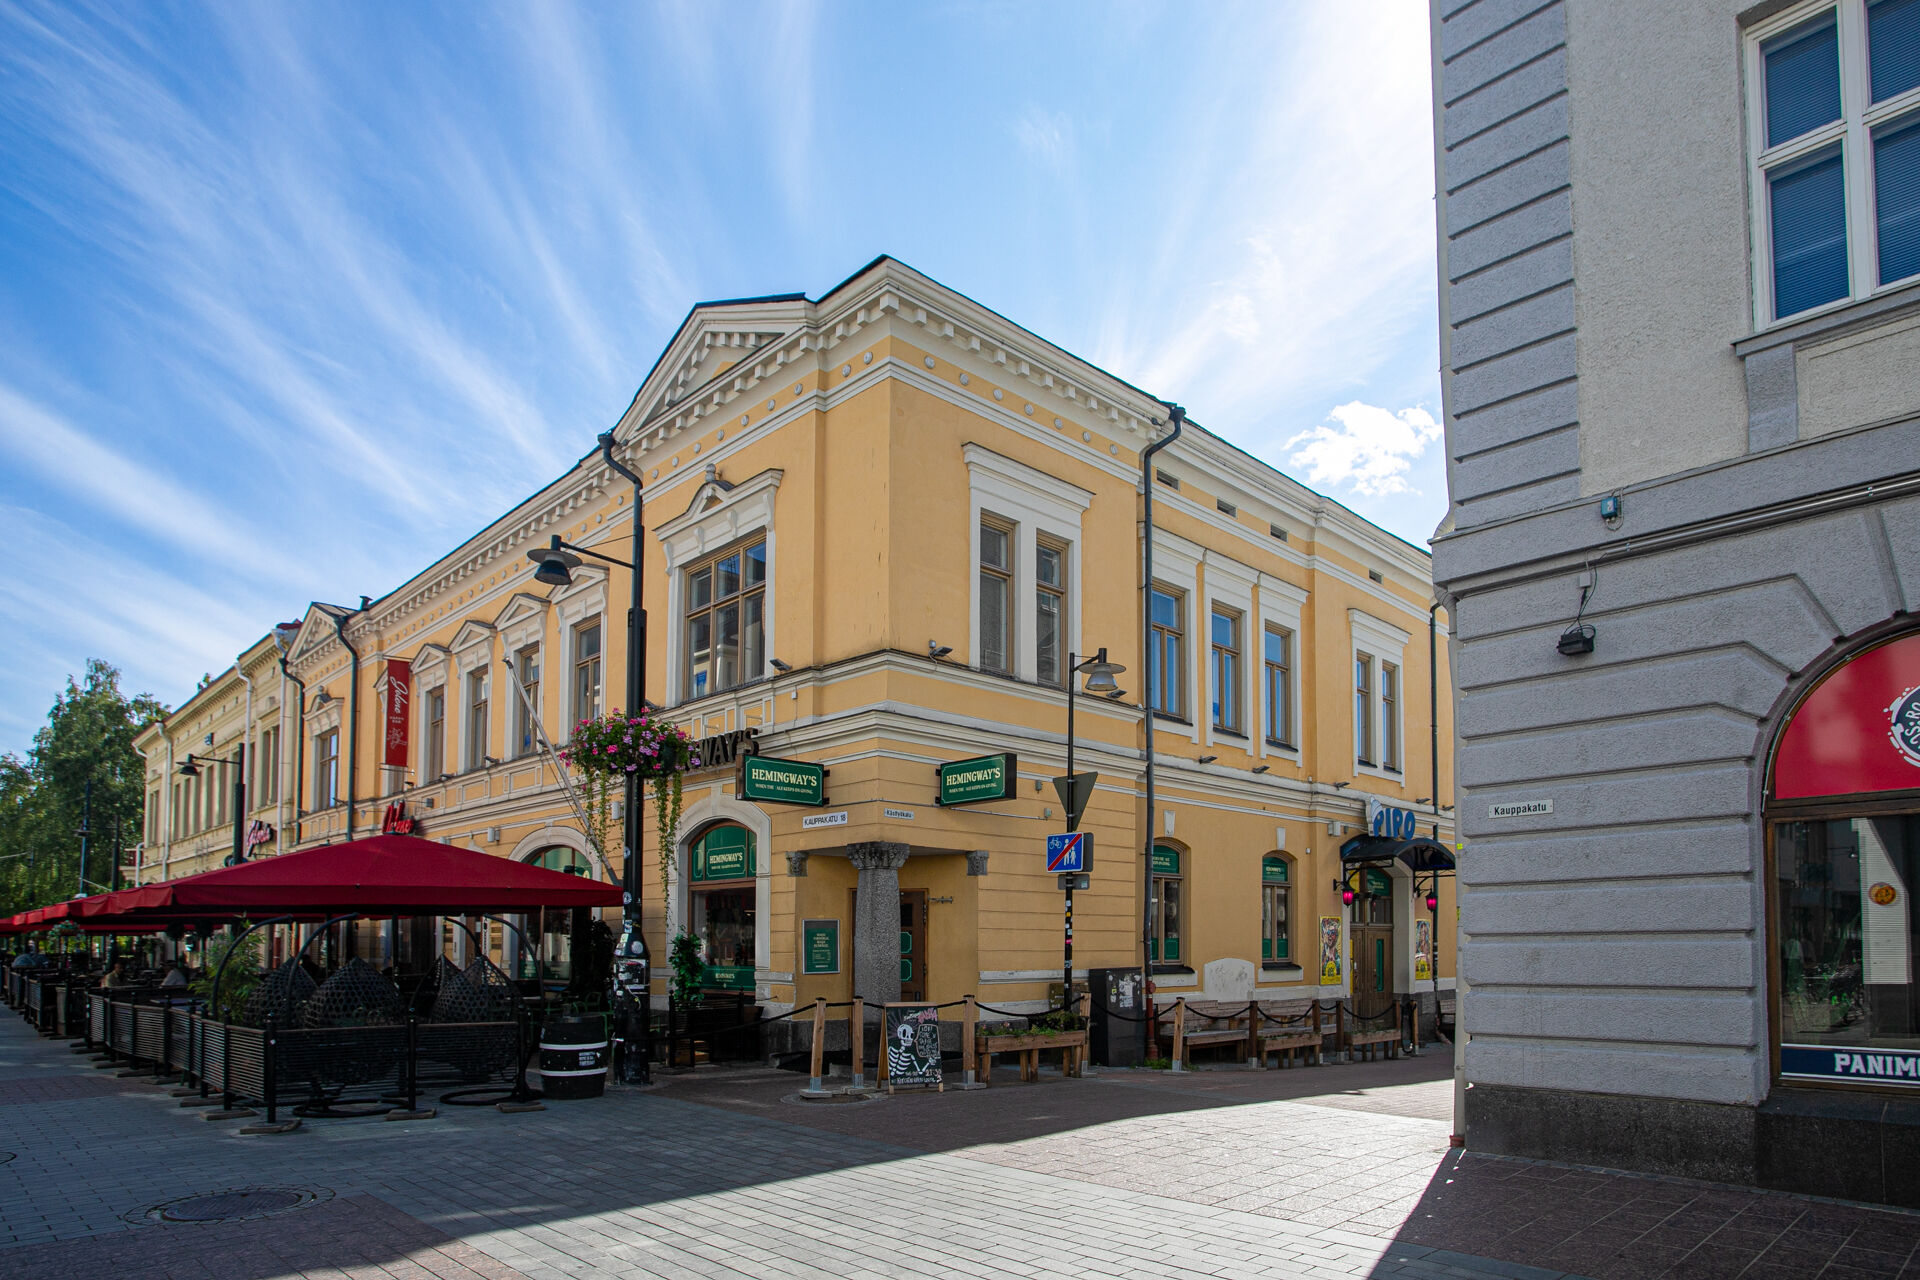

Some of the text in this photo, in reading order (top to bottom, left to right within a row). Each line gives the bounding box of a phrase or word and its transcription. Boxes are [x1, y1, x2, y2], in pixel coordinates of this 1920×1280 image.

[389, 676, 408, 714] Jolene
[751, 768, 818, 787] HEMINGWAY'S
[946, 767, 1001, 786] HEMINGWAY'S
[1494, 803, 1547, 816] Kauppakatu
[804, 813, 847, 826] KAUPPAKATU 18
[1373, 807, 1416, 840] PIPO
[709, 852, 743, 864] HEMINGWAY'S
[1834, 1053, 1920, 1078] PANIM
